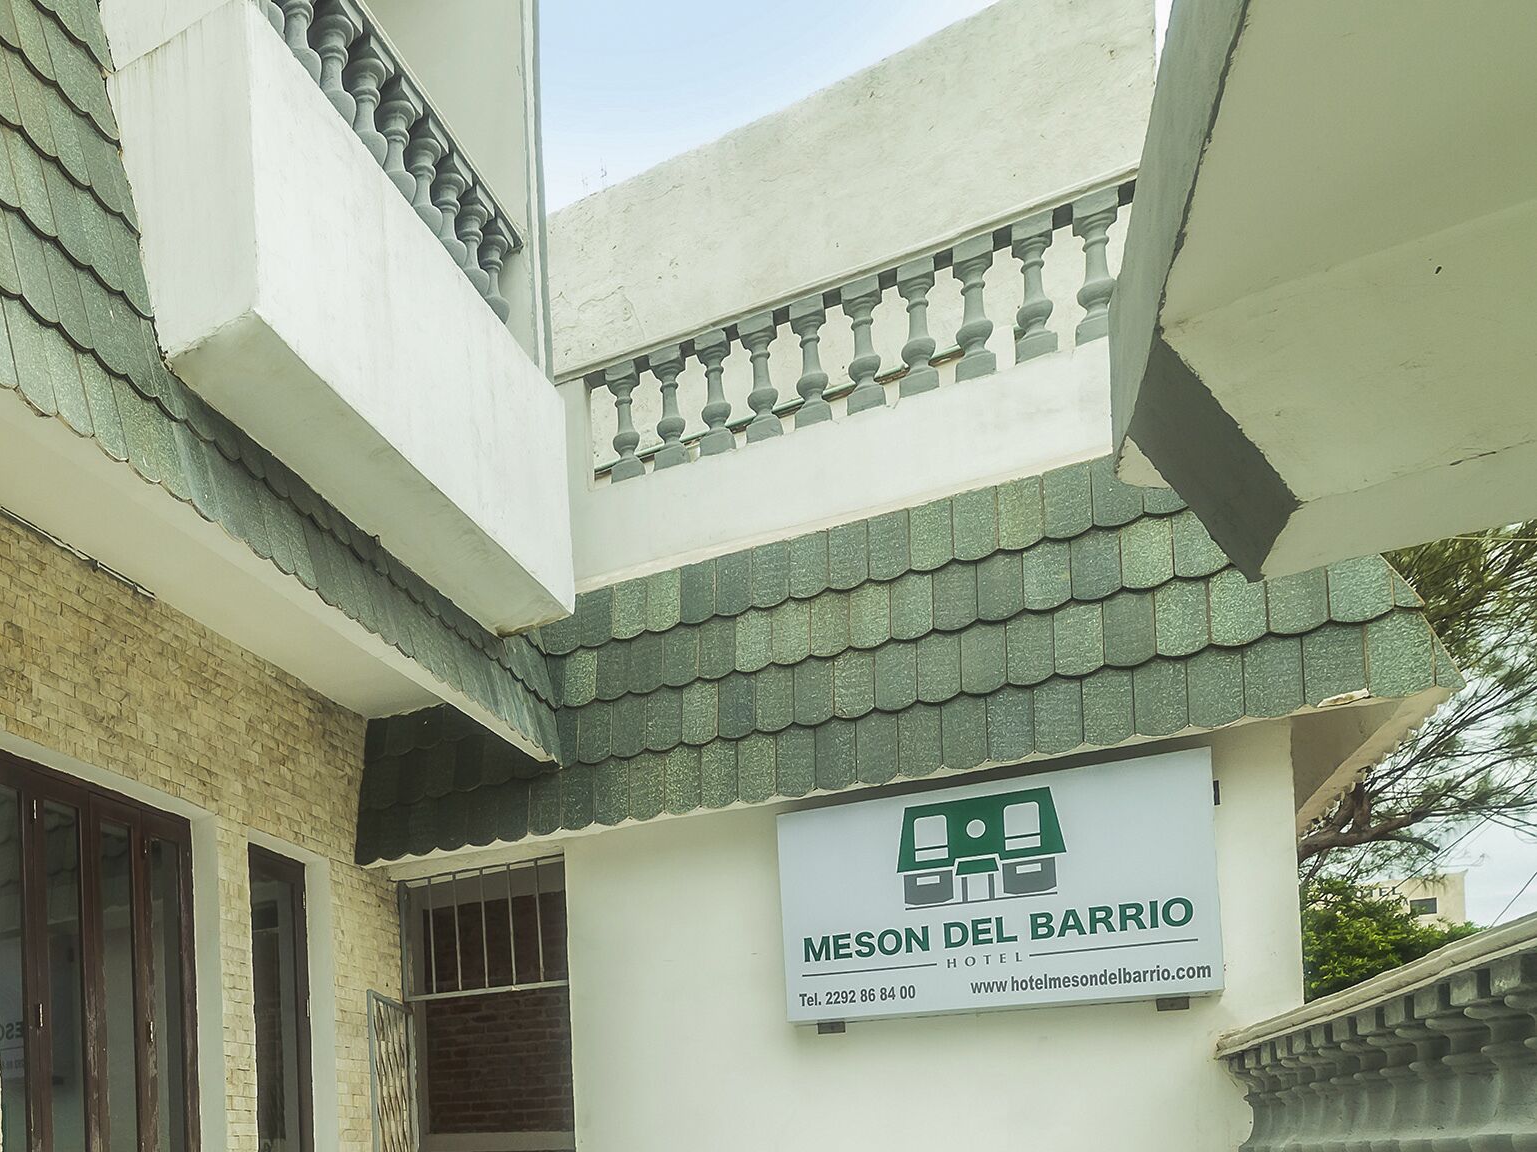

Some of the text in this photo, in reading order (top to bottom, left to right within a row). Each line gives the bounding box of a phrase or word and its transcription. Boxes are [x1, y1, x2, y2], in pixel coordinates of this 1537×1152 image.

[803, 897, 1194, 963] MESON DEL BARRIO
[947, 952, 1023, 969] HOTEL
[799, 984, 916, 1007] Tel. 2292 86 84 00
